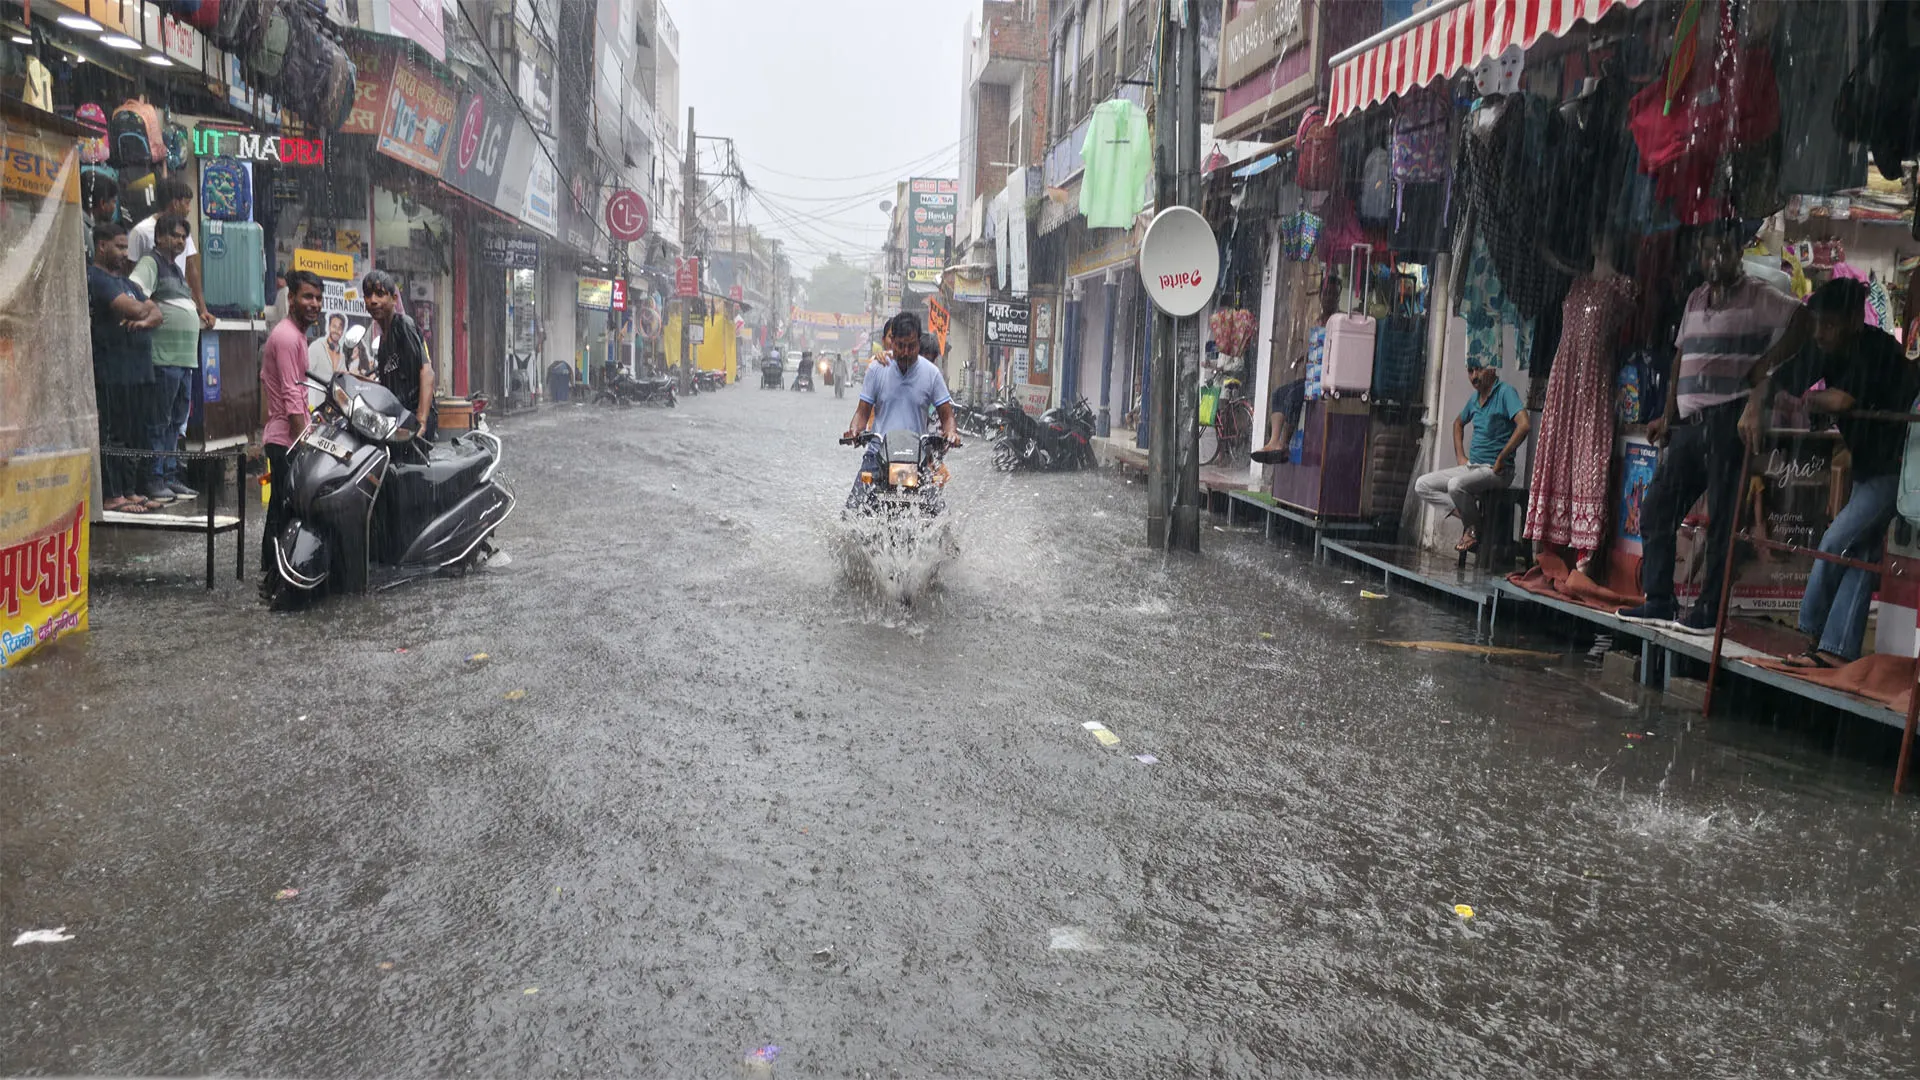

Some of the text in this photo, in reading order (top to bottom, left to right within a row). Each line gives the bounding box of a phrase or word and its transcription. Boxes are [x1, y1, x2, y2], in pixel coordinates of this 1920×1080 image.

[1246, 19, 1259, 54] BAG
[475, 116, 501, 176] LG
[299, 256, 349, 273] kamiliant
[323, 284, 344, 296] TOUGH
[1159, 273, 1189, 290] airtel
[322, 297, 368, 314] TERNATION
[988, 303, 1011, 320] नज़र
[1764, 448, 1815, 488] Lyra
[1752, 600, 1777, 608] VENUS
